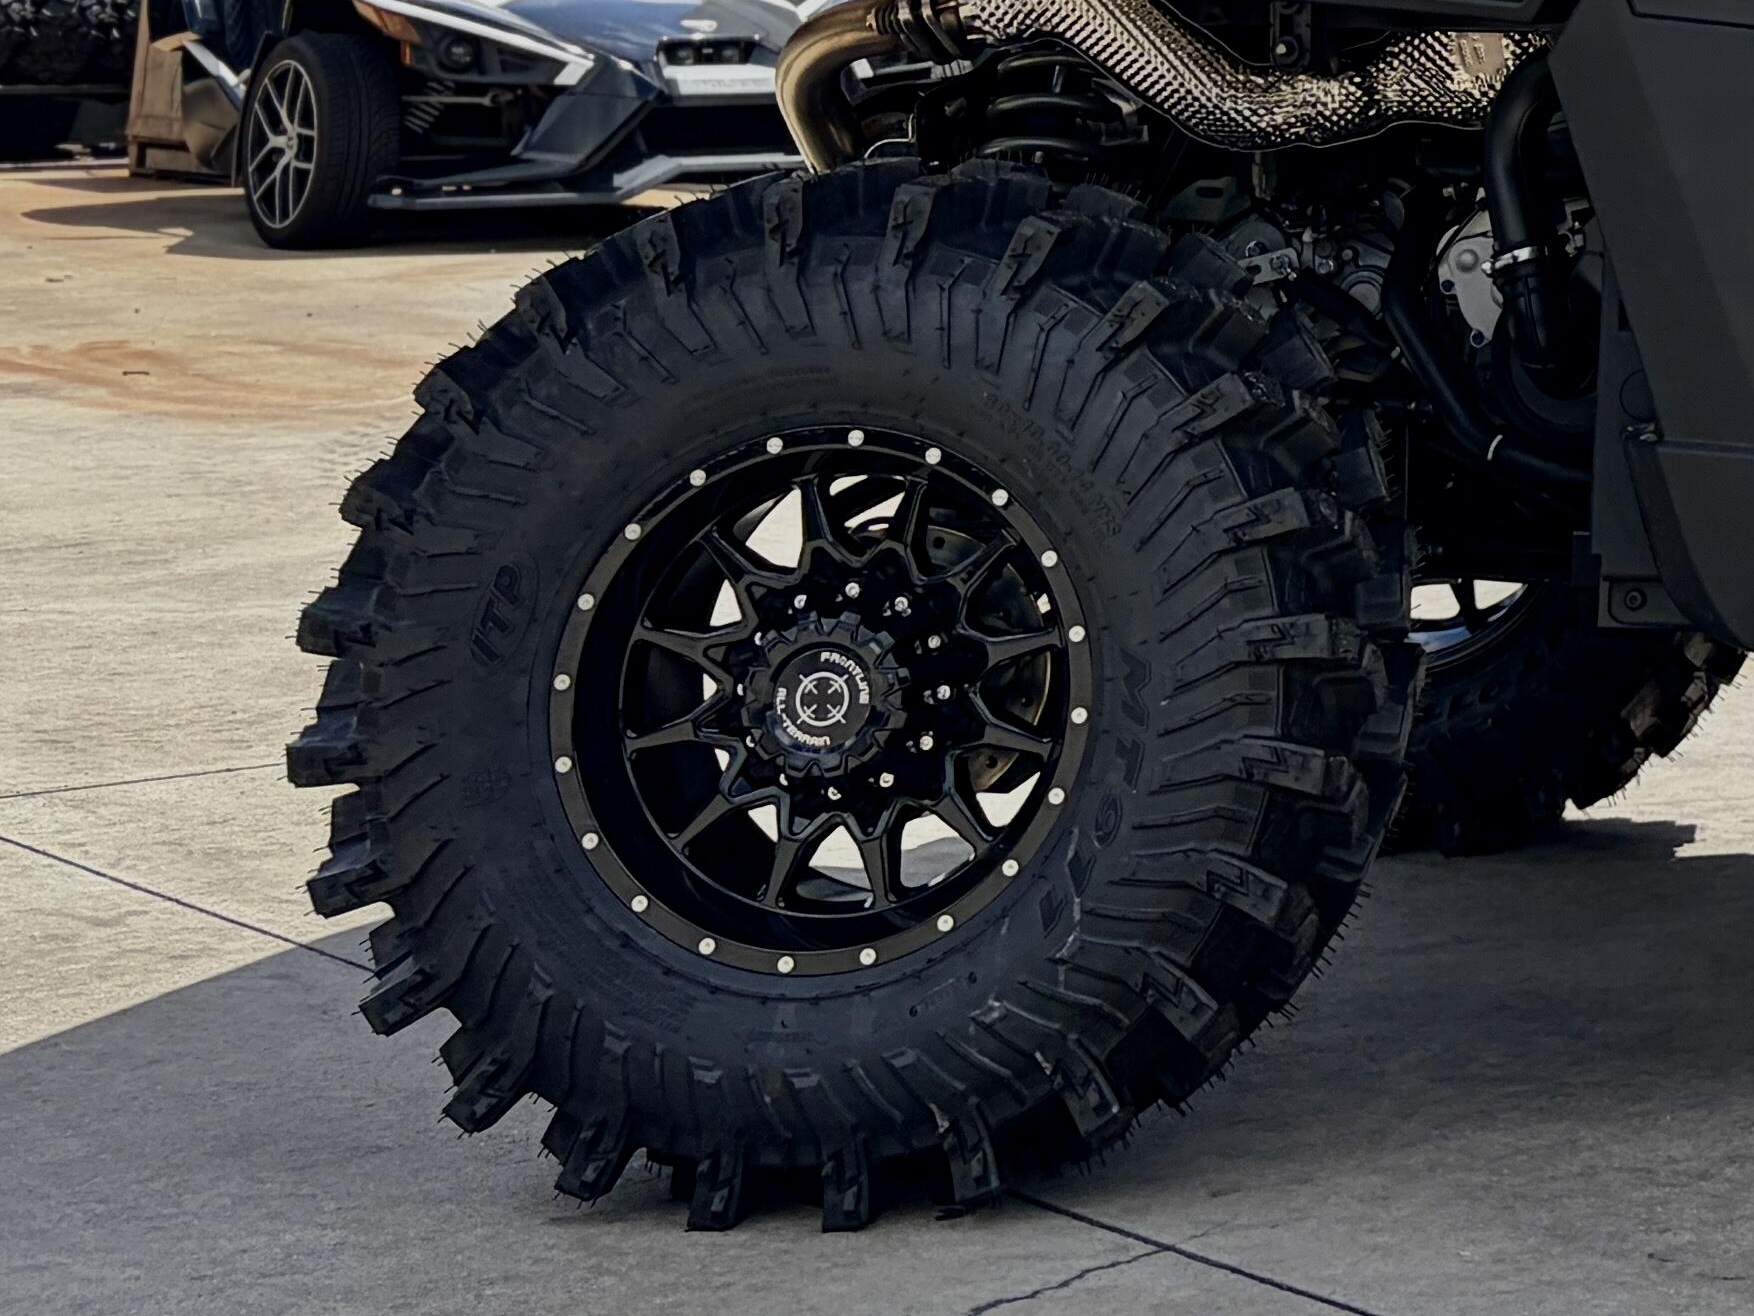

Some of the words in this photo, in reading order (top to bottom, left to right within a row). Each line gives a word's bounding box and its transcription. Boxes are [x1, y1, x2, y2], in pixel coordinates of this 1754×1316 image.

[472, 564, 520, 664] ITP
[820, 651, 870, 704] FRONTLINE
[776, 687, 830, 746] ALL-TERRAIN
